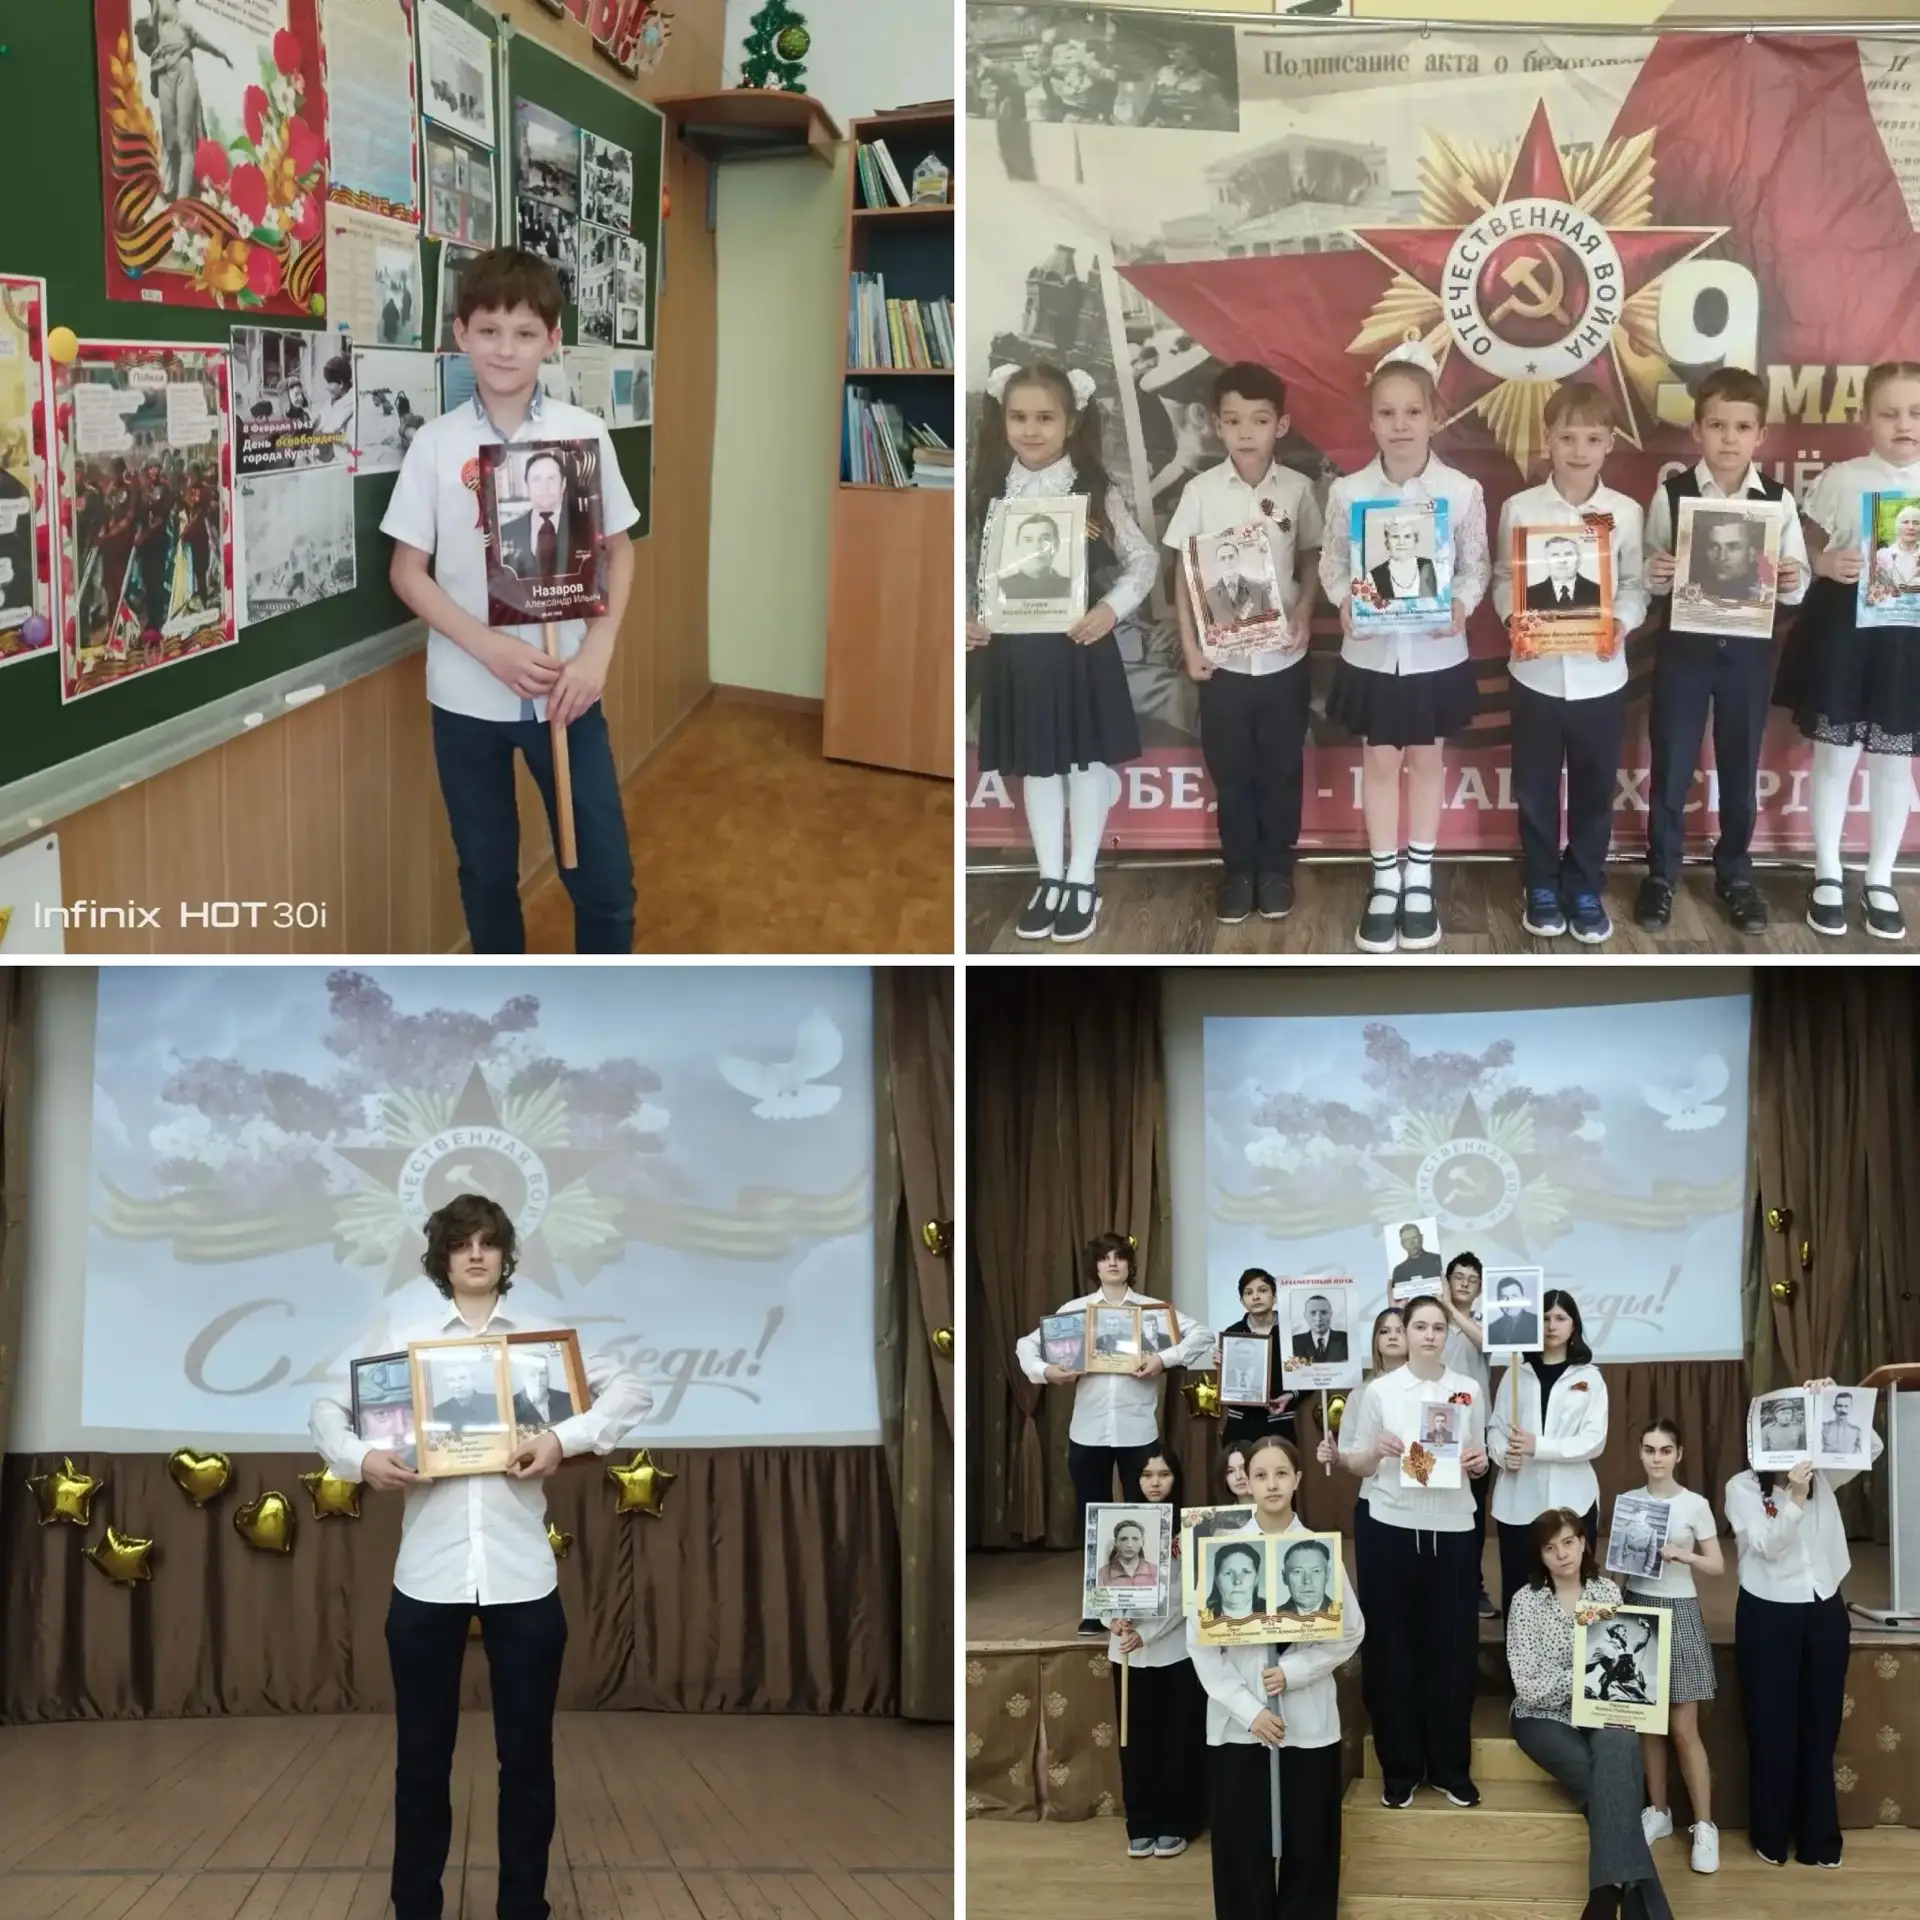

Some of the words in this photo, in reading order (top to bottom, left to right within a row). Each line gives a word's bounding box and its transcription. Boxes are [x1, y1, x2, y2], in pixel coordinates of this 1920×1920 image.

[1262, 50, 1410, 80] Подписание
[1425, 54, 1478, 72] акта
[1494, 55, 1508, 74] о
[1449, 206, 1602, 356] ОТЕЧЕСТВЕННАЯ
[1564, 262, 1617, 359] ВОЙНА
[1657, 259, 1759, 428] 9
[1767, 365, 1868, 423] МА
[251, 422, 290, 433] Февраля
[243, 439, 272, 453] День
[243, 452, 282, 465] города
[532, 583, 584, 597] Назаров
[525, 596, 572, 609] Александр
